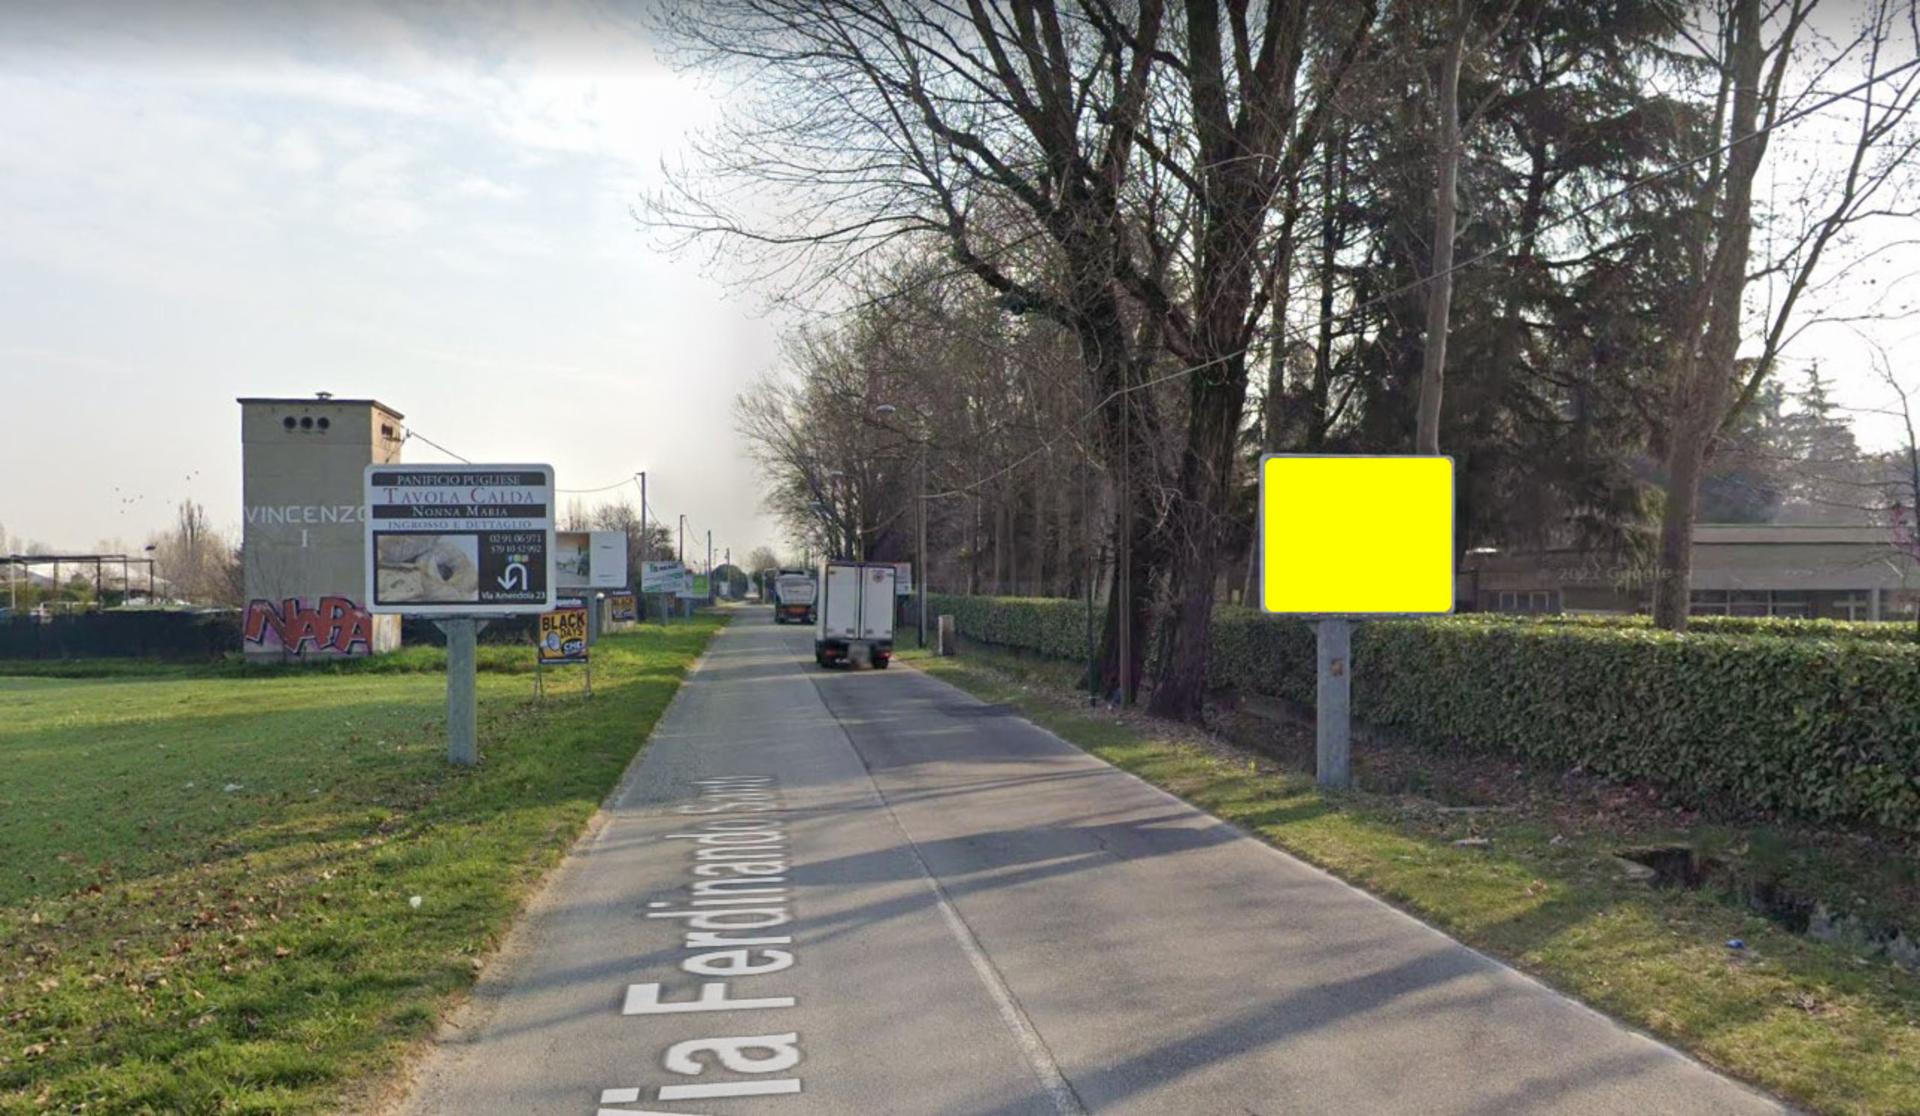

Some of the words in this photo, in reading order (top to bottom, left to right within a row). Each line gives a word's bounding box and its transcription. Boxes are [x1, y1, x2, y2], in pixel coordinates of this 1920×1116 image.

[397, 475, 461, 485] PANIFICIO
[463, 475, 521, 485] PUGLIESE
[383, 487, 460, 504] TAVOLA
[471, 486, 534, 504] CALDA
[412, 506, 461, 517] NONNA
[466, 506, 509, 517] MARIA
[388, 520, 448, 529] INGROSSO
[453, 520, 460, 529] E
[465, 520, 532, 529] DETTAGLIO
[480, 591, 494, 600] Via
[535, 591, 546, 600] 23
[542, 612, 585, 631] BLACK
[560, 626, 583, 639] DAYS
